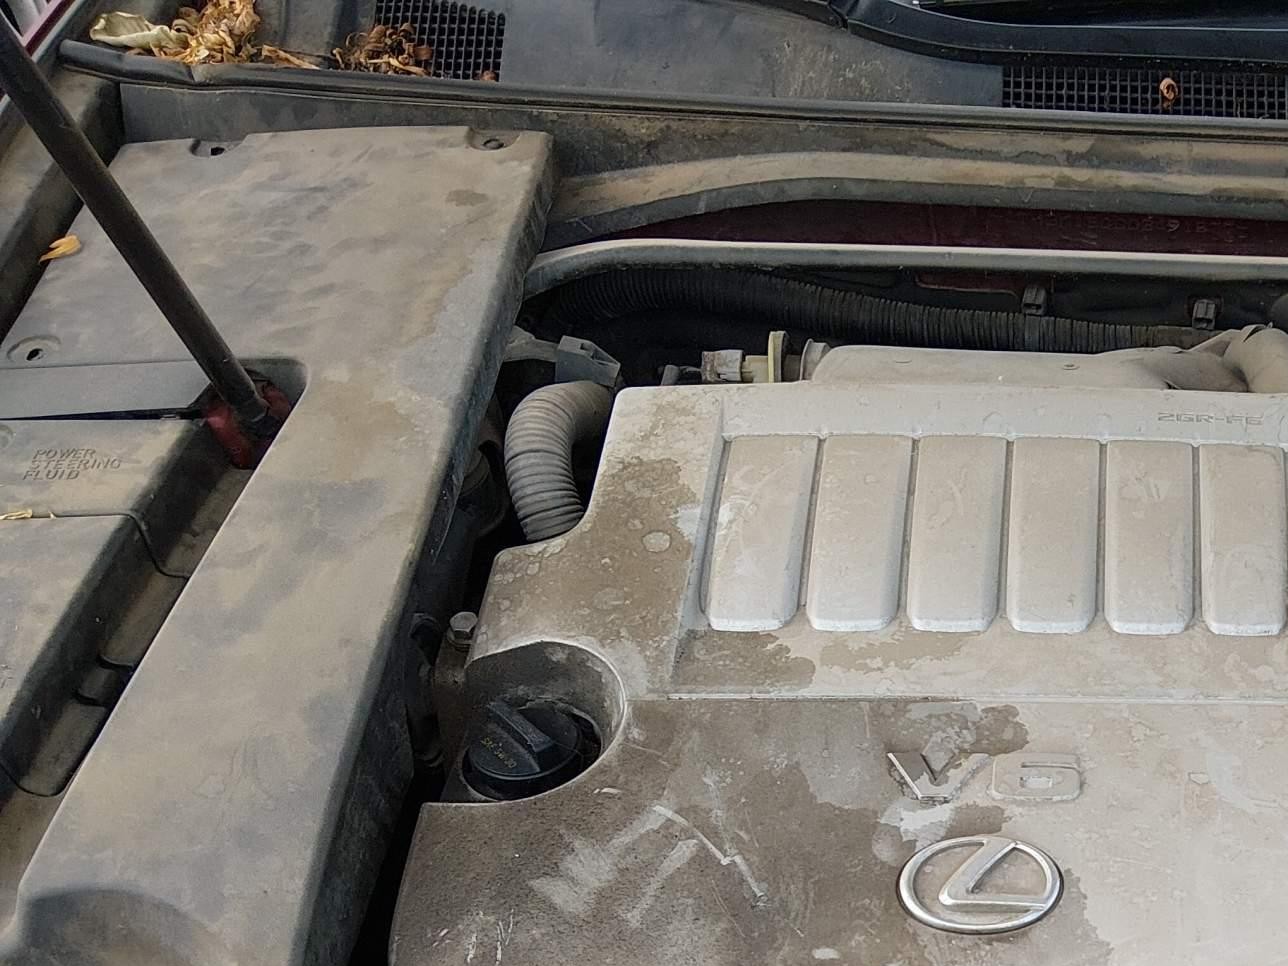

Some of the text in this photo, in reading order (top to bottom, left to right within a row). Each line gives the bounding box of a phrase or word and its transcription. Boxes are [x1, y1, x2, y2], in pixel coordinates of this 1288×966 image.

[33, 448, 97, 459] POWER
[29, 457, 122, 471] STEERING
[22, 469, 81, 481] FLUID
[886, 752, 1082, 802] V6
